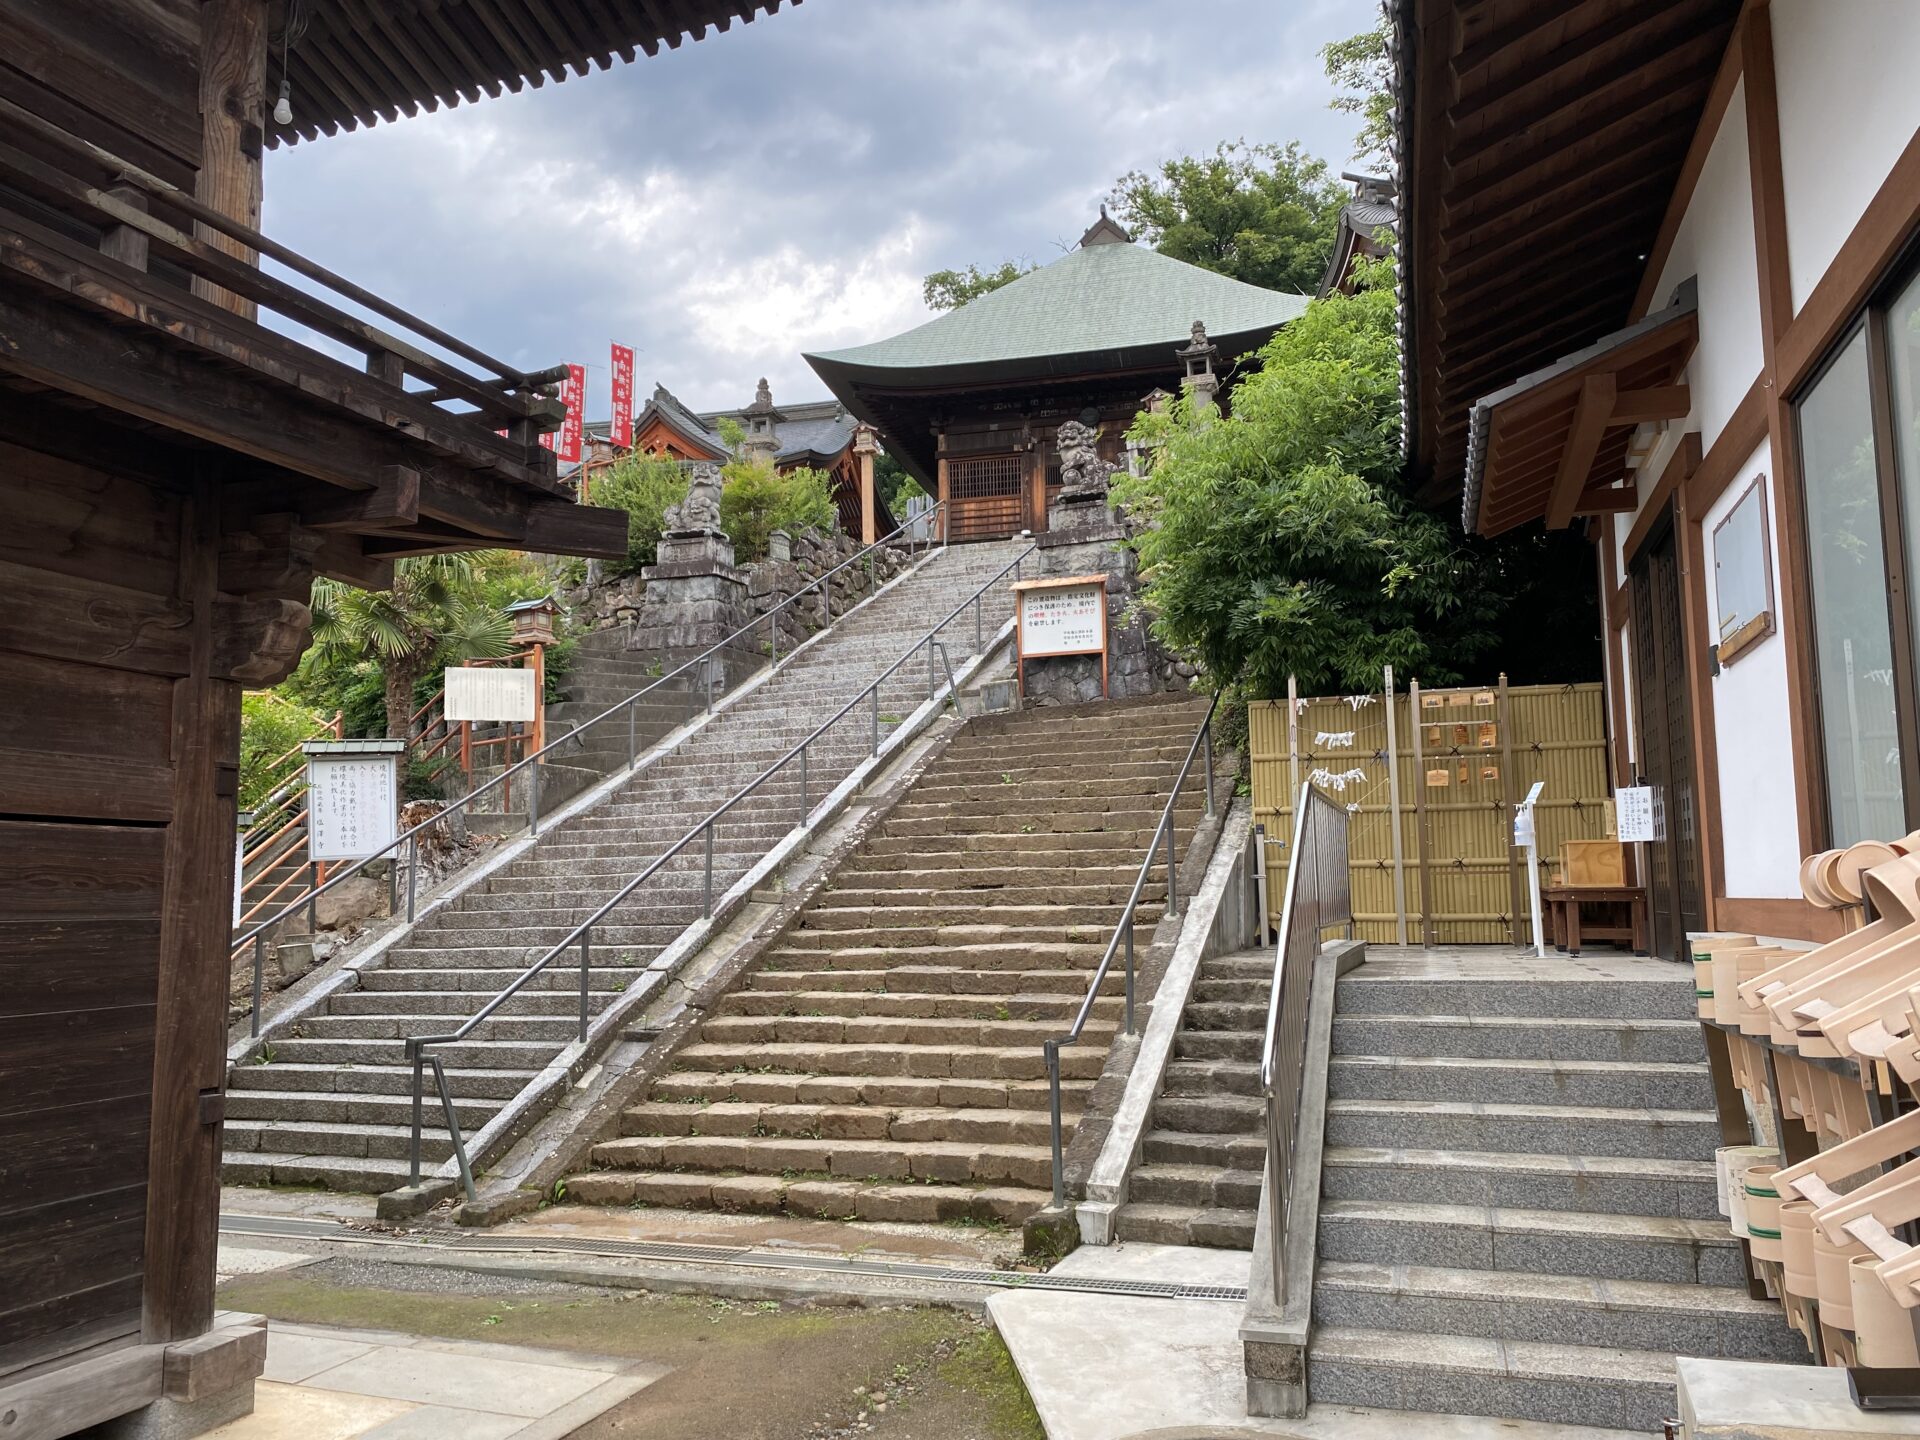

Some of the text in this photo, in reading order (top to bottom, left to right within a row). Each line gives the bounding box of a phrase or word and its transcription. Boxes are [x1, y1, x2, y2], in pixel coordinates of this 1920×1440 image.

[564, 378, 576, 457] 南無地蔵菩薩
[616, 361, 625, 441] 南無地蔵菩薩
